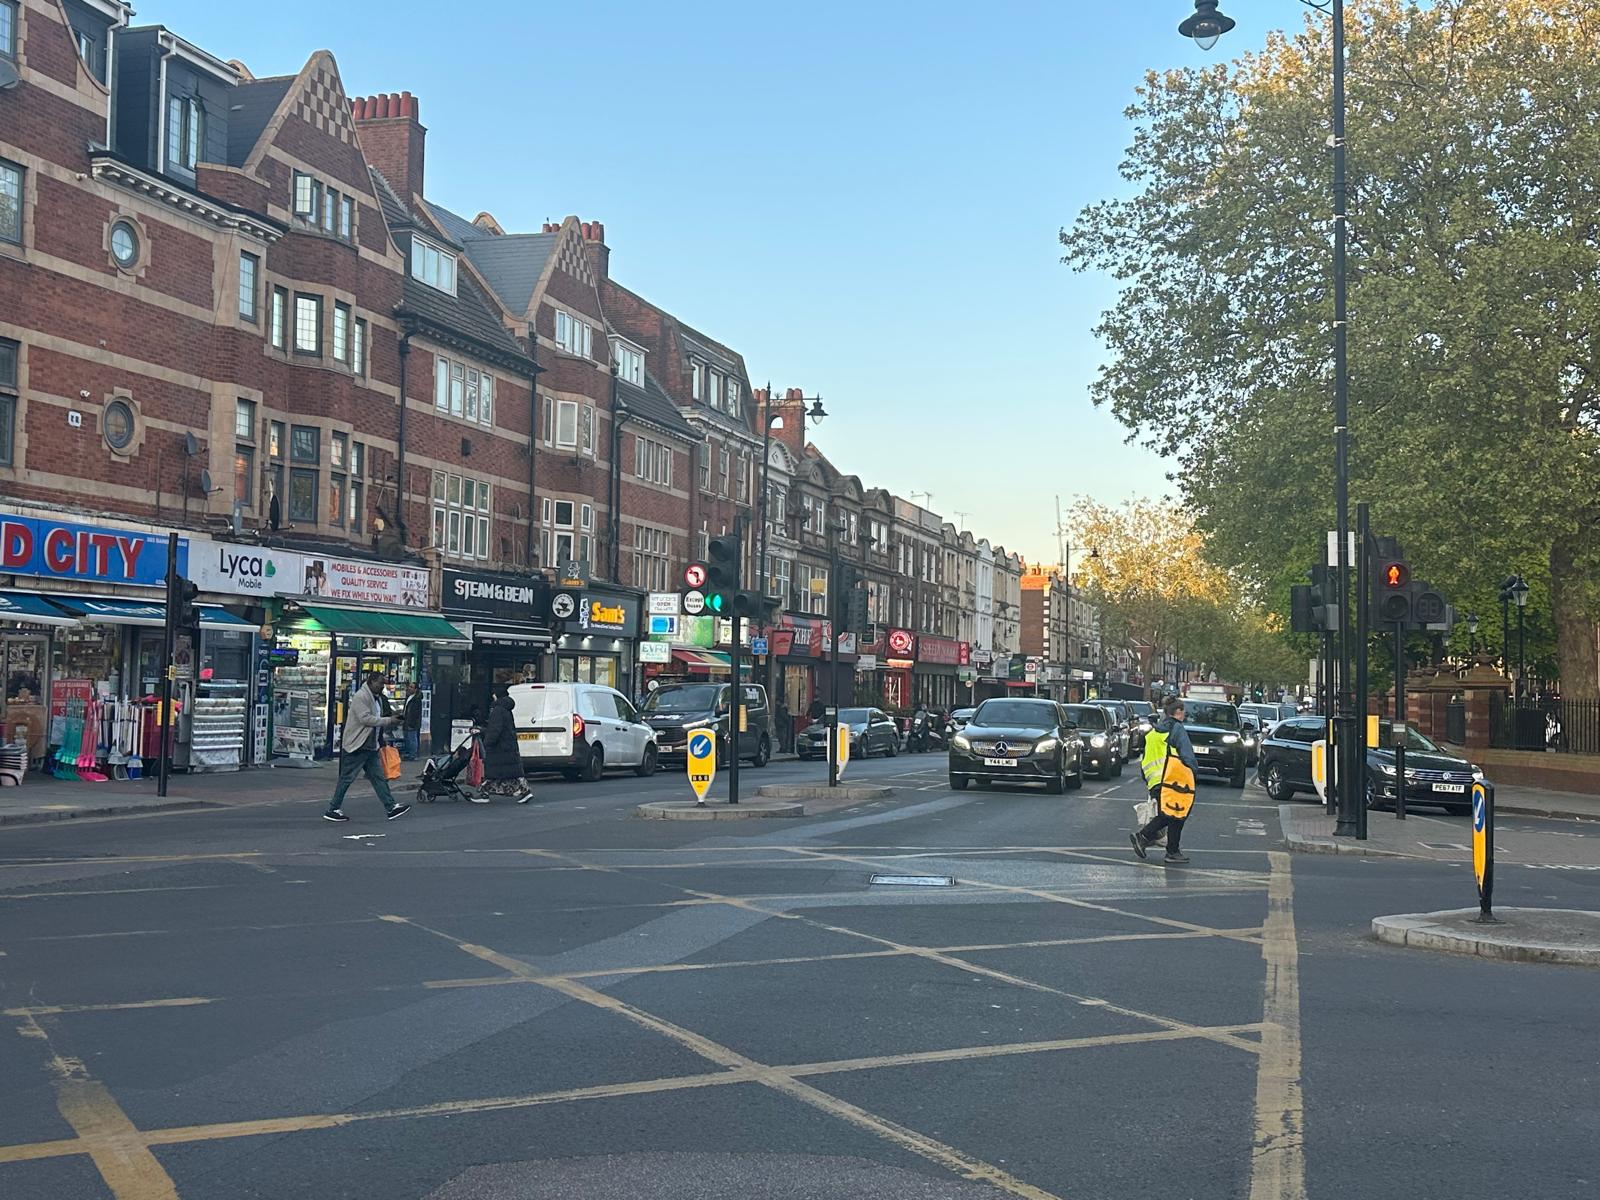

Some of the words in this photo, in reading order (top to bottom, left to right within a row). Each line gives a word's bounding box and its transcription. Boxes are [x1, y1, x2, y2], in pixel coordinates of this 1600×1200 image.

[45, 528, 144, 578] CITY
[220, 549, 262, 578] Lyca
[332, 563, 356, 574] MOBILES
[363, 567, 398, 578] ACCESSORIES
[238, 578, 262, 589] Mobile
[341, 577, 366, 587] QUALITY
[367, 580, 388, 589] SERVICE
[331, 589, 340, 597] WE
[342, 590, 351, 598] FIX
[352, 592, 369, 600] WHILE
[371, 593, 382, 601] YOU
[383, 594, 397, 603] WAIT
[591, 601, 625, 624] Sam's
[60, 688, 81, 698] SALE
